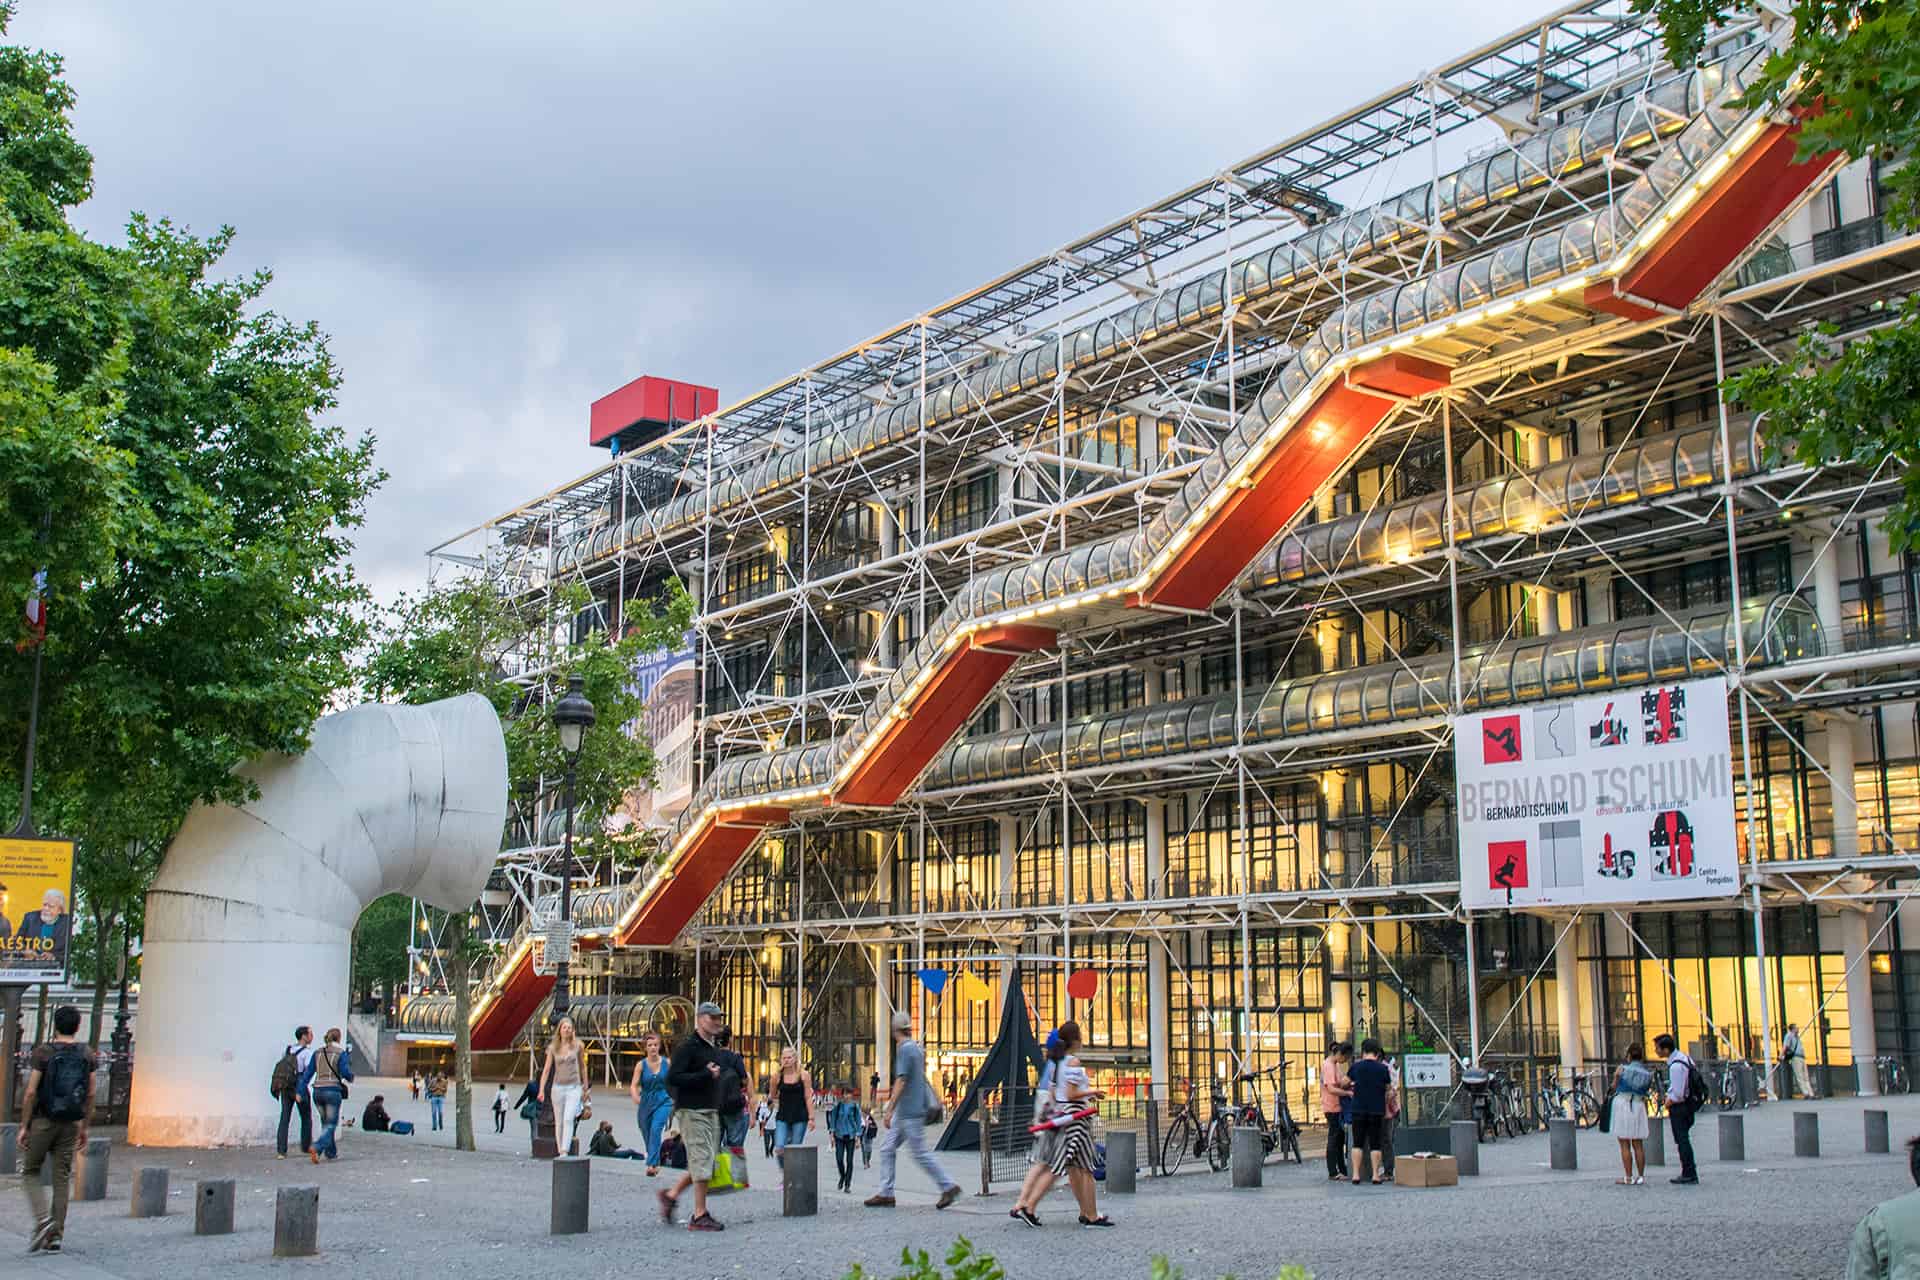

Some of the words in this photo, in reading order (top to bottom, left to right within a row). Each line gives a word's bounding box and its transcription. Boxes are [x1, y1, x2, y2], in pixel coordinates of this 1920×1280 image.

[1461, 772, 1586, 822] BERNARD
[1592, 753, 1727, 807] TSCHUMI
[1487, 805, 1527, 820] BERNARD
[1528, 801, 1568, 817] TSCHUMI
[1699, 867, 1717, 876] Centre
[1706, 876, 1734, 885] Pompidou
